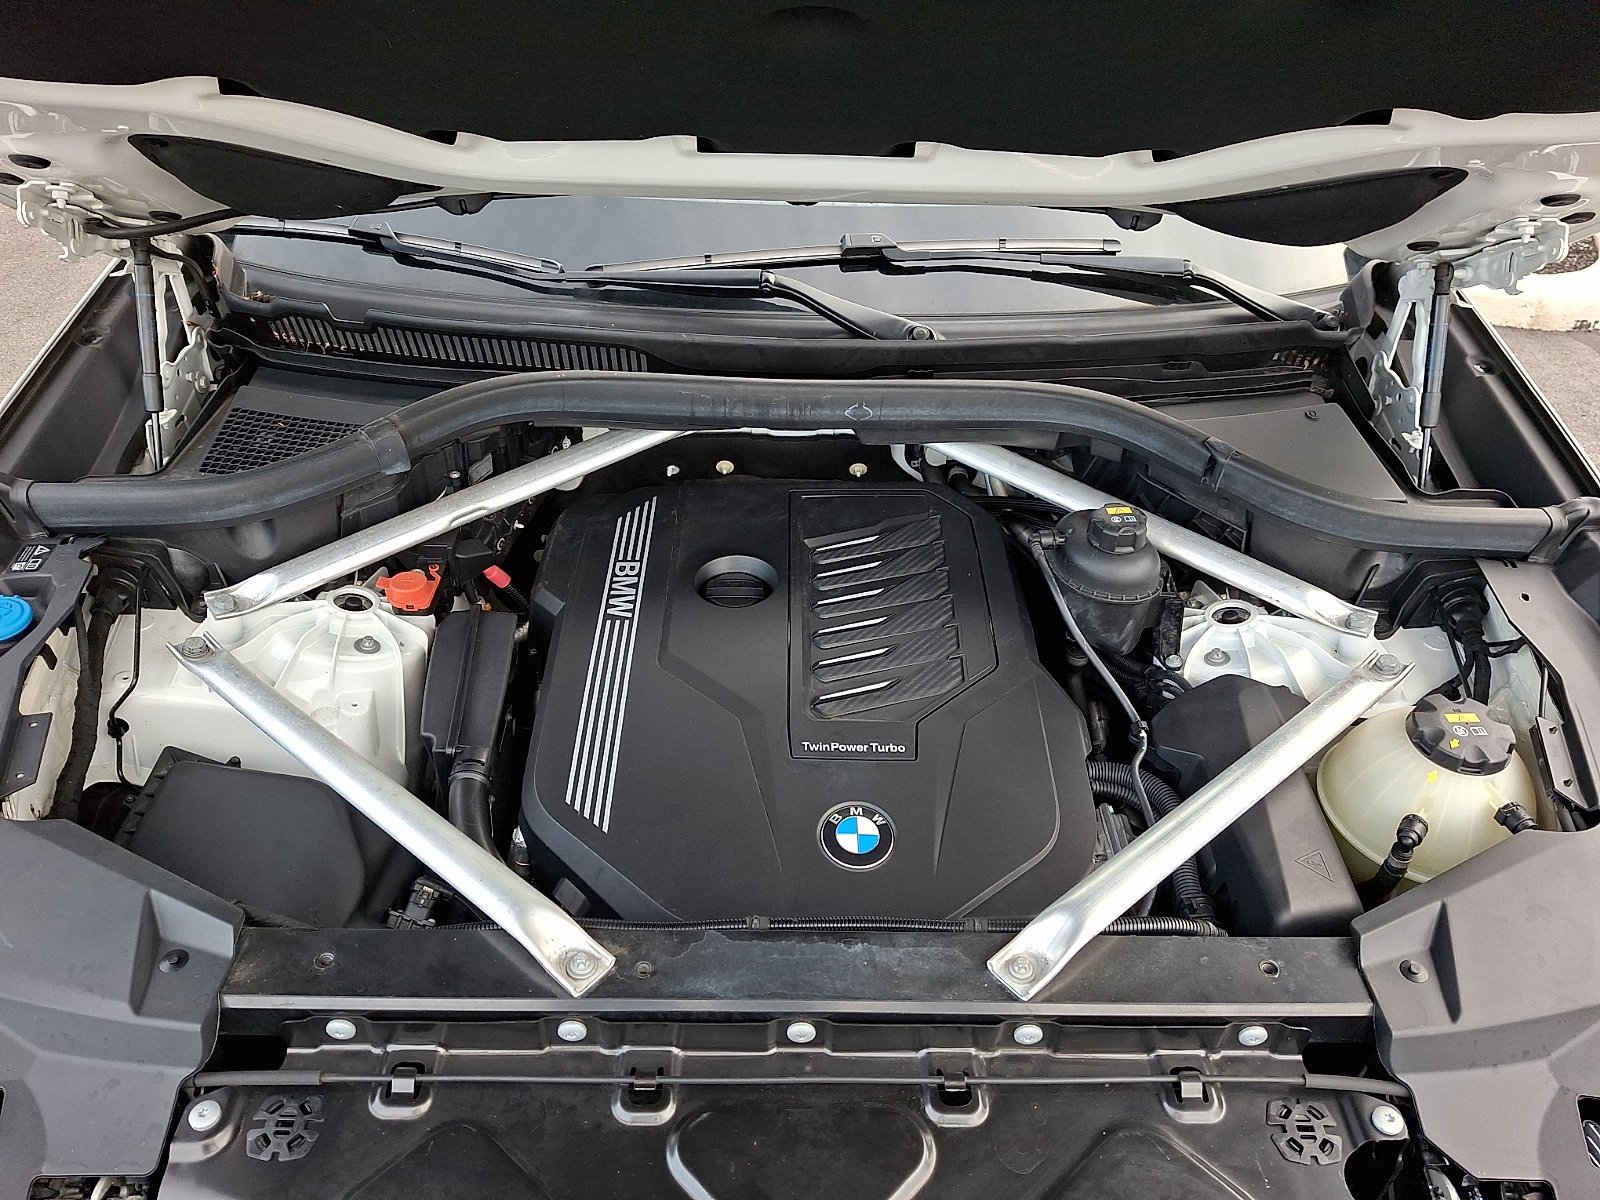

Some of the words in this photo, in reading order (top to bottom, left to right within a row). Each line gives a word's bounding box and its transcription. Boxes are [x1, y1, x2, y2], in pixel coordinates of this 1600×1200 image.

[606, 561, 641, 618] BMW
[801, 741, 869, 753] TwinPower
[869, 742, 906, 753] Turbo
[828, 806, 887, 826] BMW
